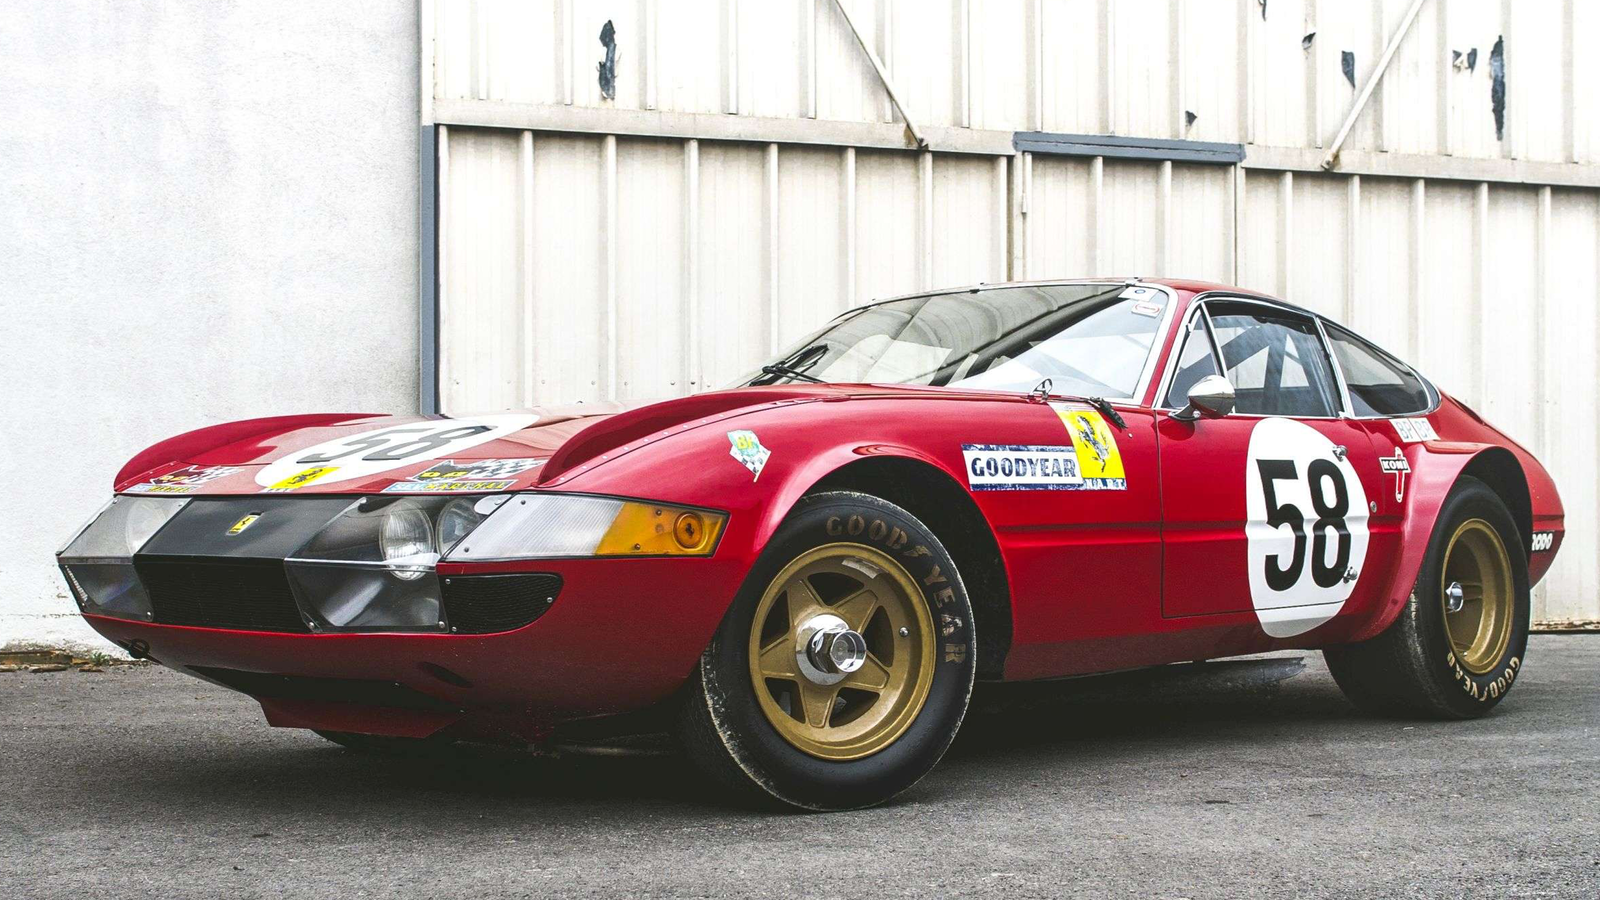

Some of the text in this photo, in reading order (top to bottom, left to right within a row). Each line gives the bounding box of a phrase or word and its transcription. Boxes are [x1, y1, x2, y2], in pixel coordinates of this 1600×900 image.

[1395, 421, 1432, 439] BP BP
[297, 425, 497, 464] 58
[971, 457, 1076, 477] GOODYEAR
[1382, 460, 1408, 469] KONI
[1256, 458, 1350, 592] 58
